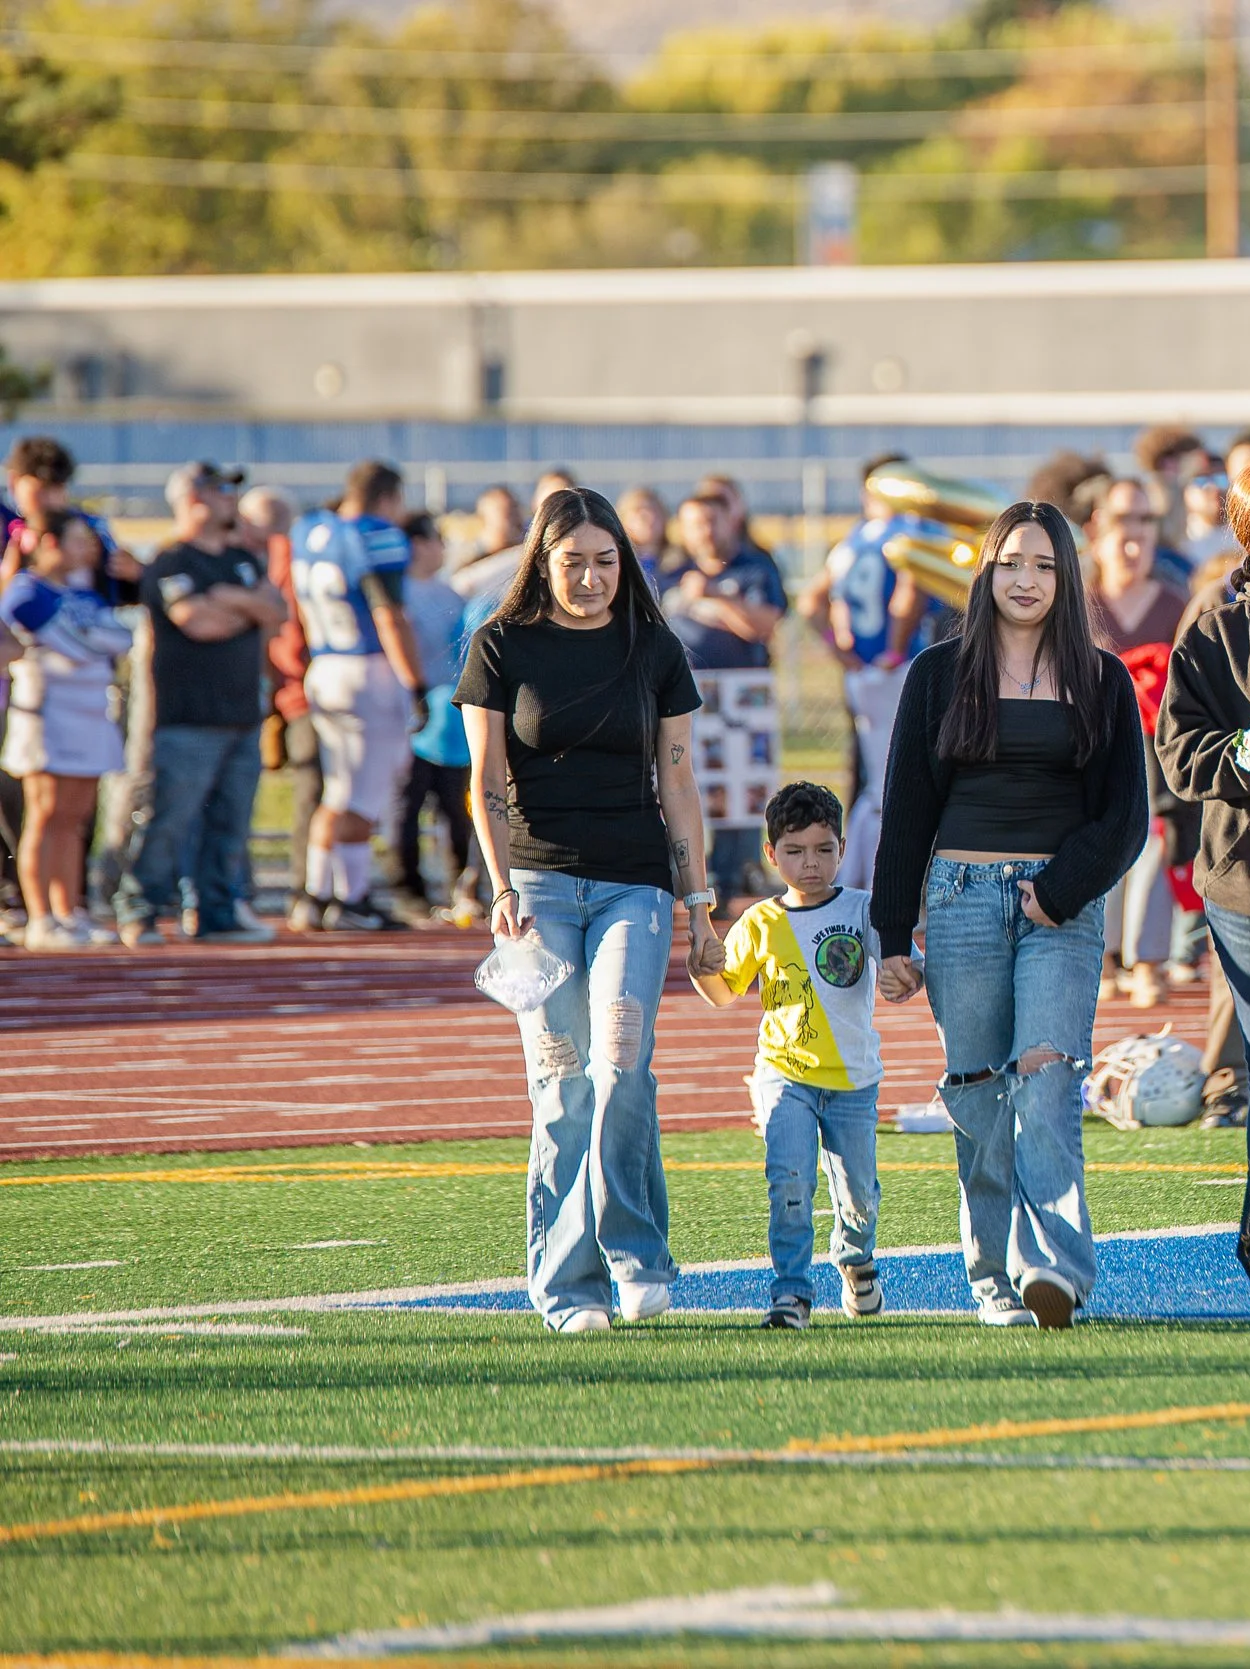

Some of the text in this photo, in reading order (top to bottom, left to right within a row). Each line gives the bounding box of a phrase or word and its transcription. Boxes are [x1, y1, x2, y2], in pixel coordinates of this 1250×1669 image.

[811, 930, 827, 945] LIFE
[824, 924, 846, 936] FINDS
[847, 925, 853, 934] A
